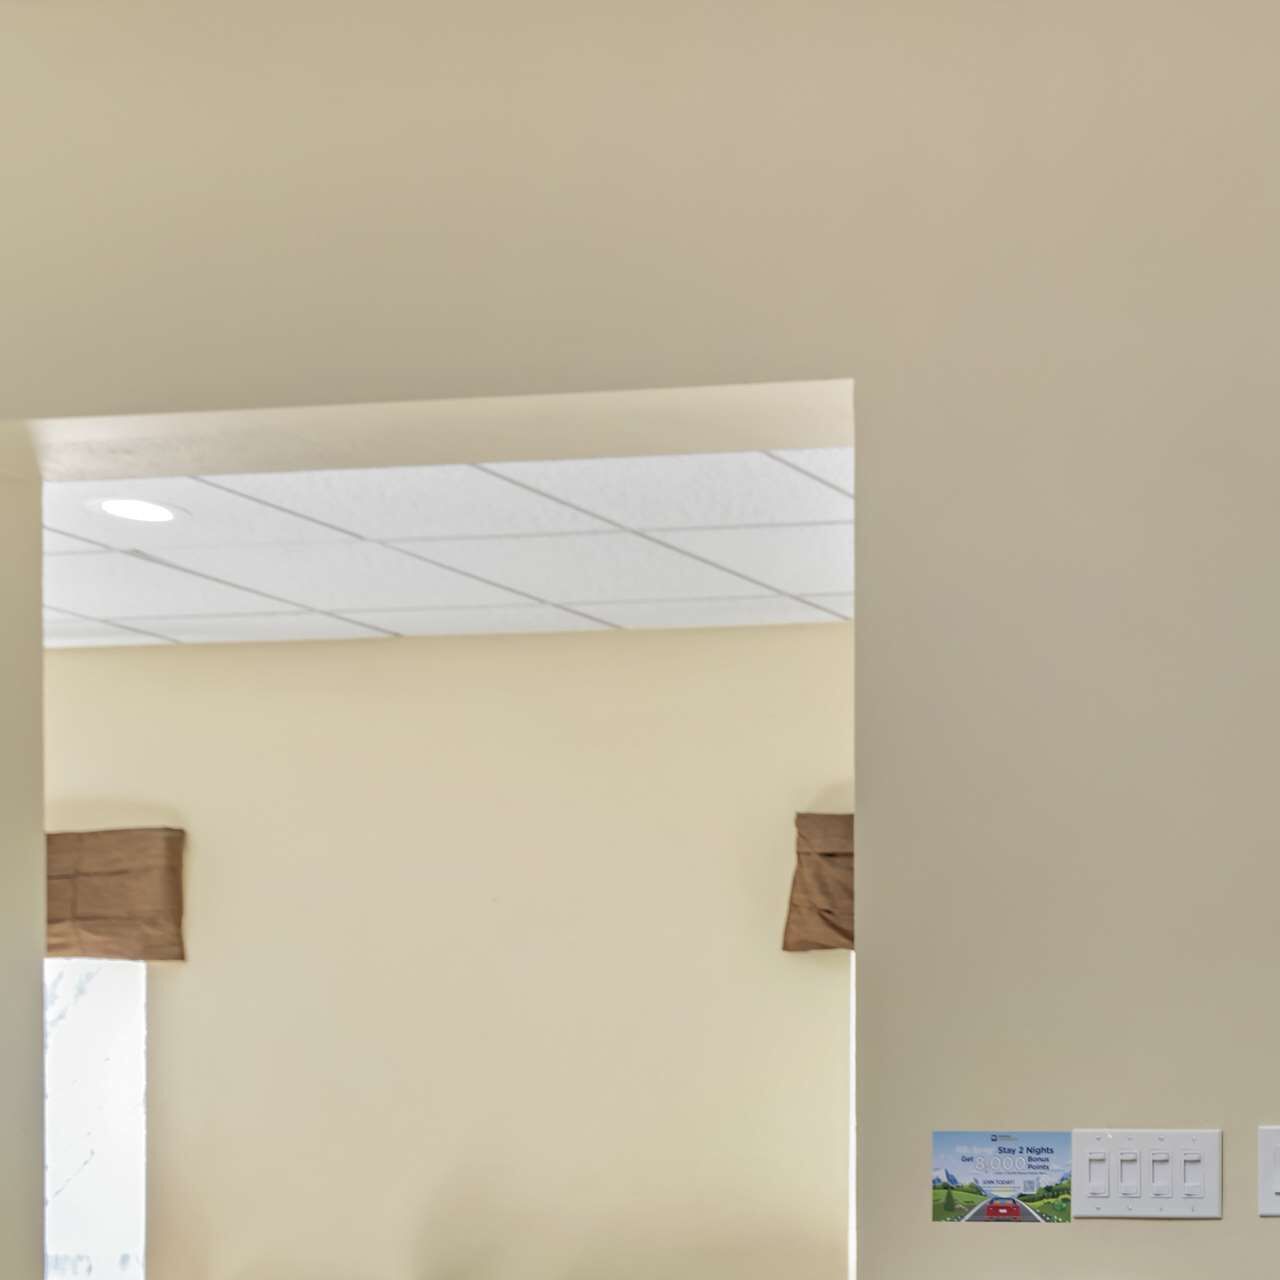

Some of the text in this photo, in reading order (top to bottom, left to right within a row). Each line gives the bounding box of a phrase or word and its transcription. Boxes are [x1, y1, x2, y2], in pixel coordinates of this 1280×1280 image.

[998, 1146, 1017, 1155] Stay
[1018, 1146, 1024, 1154] 2
[1026, 1145, 1054, 1155] Nights
